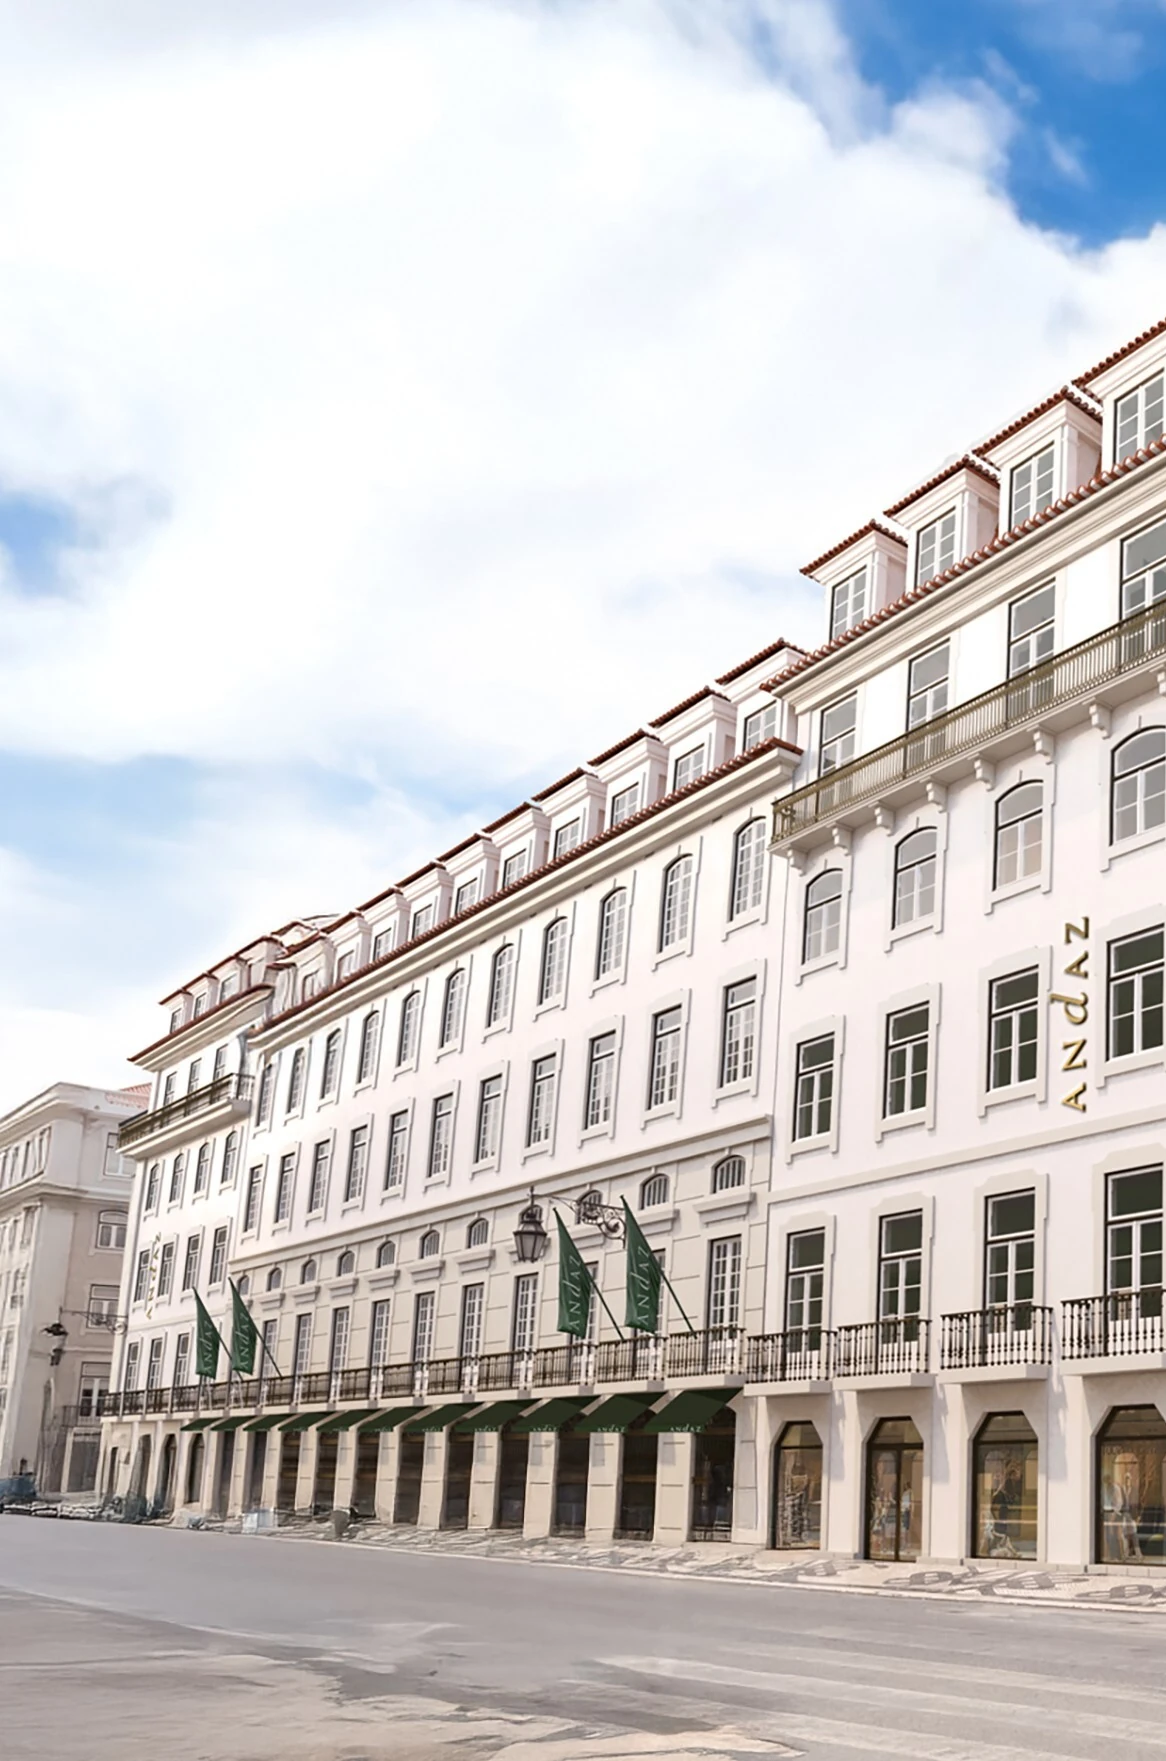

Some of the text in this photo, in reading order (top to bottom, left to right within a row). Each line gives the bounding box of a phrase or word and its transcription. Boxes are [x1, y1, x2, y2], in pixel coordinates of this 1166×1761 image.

[1050, 916, 1089, 1113] ANdAZ
[562, 1255, 581, 1330] ANdAZ
[630, 1246, 649, 1326] ANdAZ
